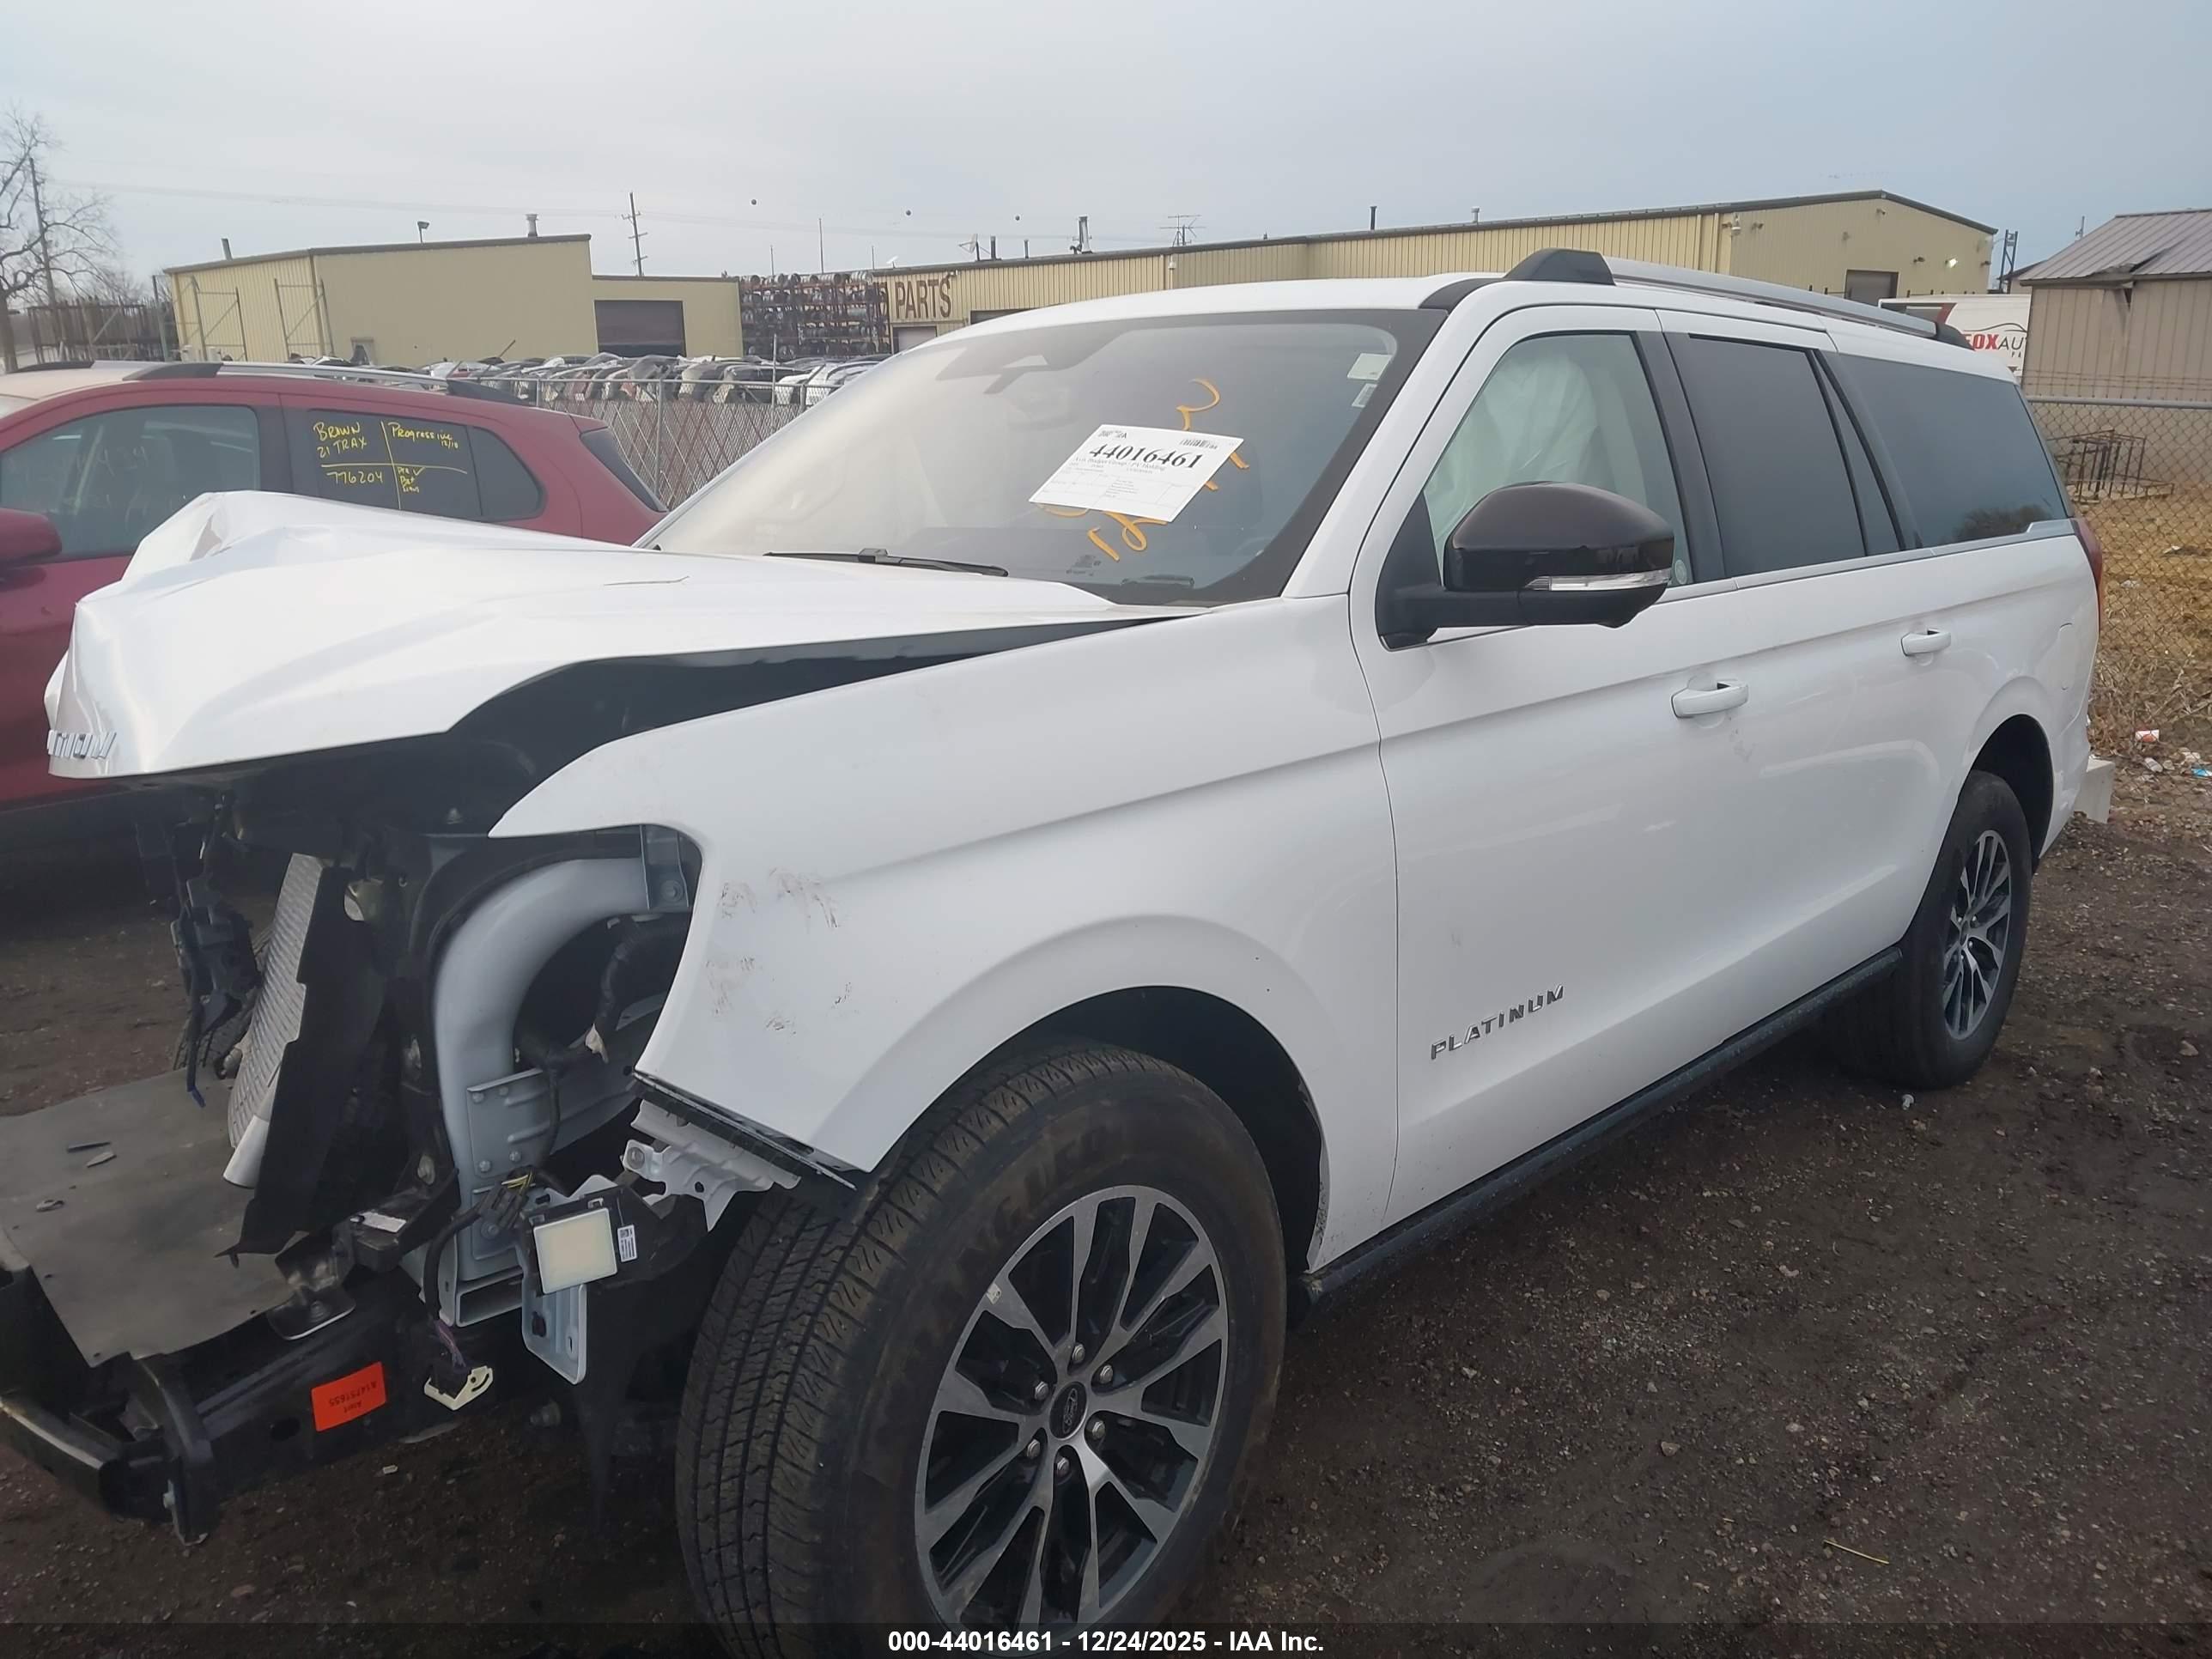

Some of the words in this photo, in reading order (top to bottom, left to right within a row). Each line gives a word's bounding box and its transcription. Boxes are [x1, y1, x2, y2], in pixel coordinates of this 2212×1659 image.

[895, 276, 951, 319] PARTS
[317, 447, 331, 459] 21
[333, 436, 368, 454] TRAX
[1089, 443, 1204, 470] 44016461
[326, 471, 384, 485] 776204
[1431, 984, 1565, 1060] PLATINUM
